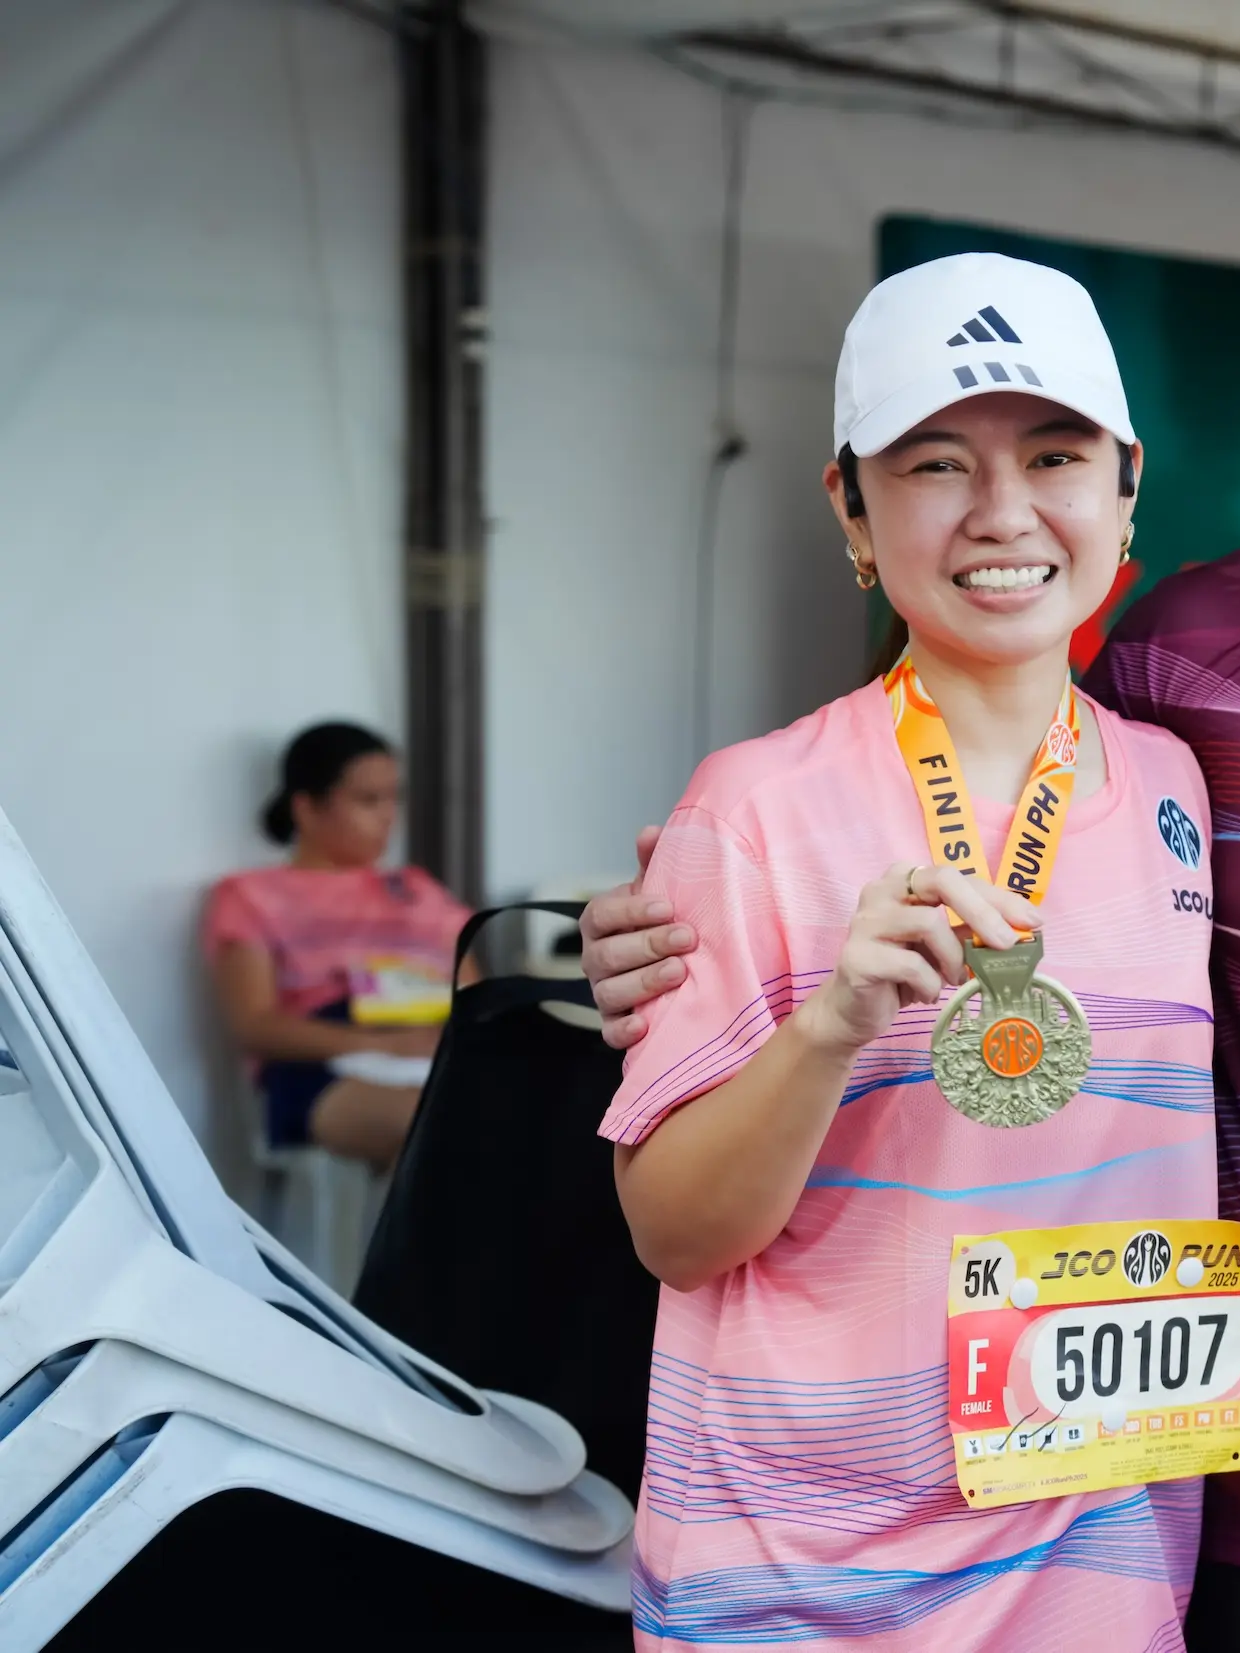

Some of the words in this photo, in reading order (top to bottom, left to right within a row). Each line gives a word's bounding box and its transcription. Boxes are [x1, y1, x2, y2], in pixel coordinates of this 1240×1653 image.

[918, 753, 977, 877] FINIS
[1026, 781, 1060, 834] PH
[964, 1257, 1002, 1298] 5K
[1039, 1248, 1117, 1280] JCO
[1207, 1271, 1240, 1288] 2025
[967, 1338, 990, 1396] F
[1055, 1313, 1229, 1402] 50107
[960, 1399, 992, 1416] FEMALE
